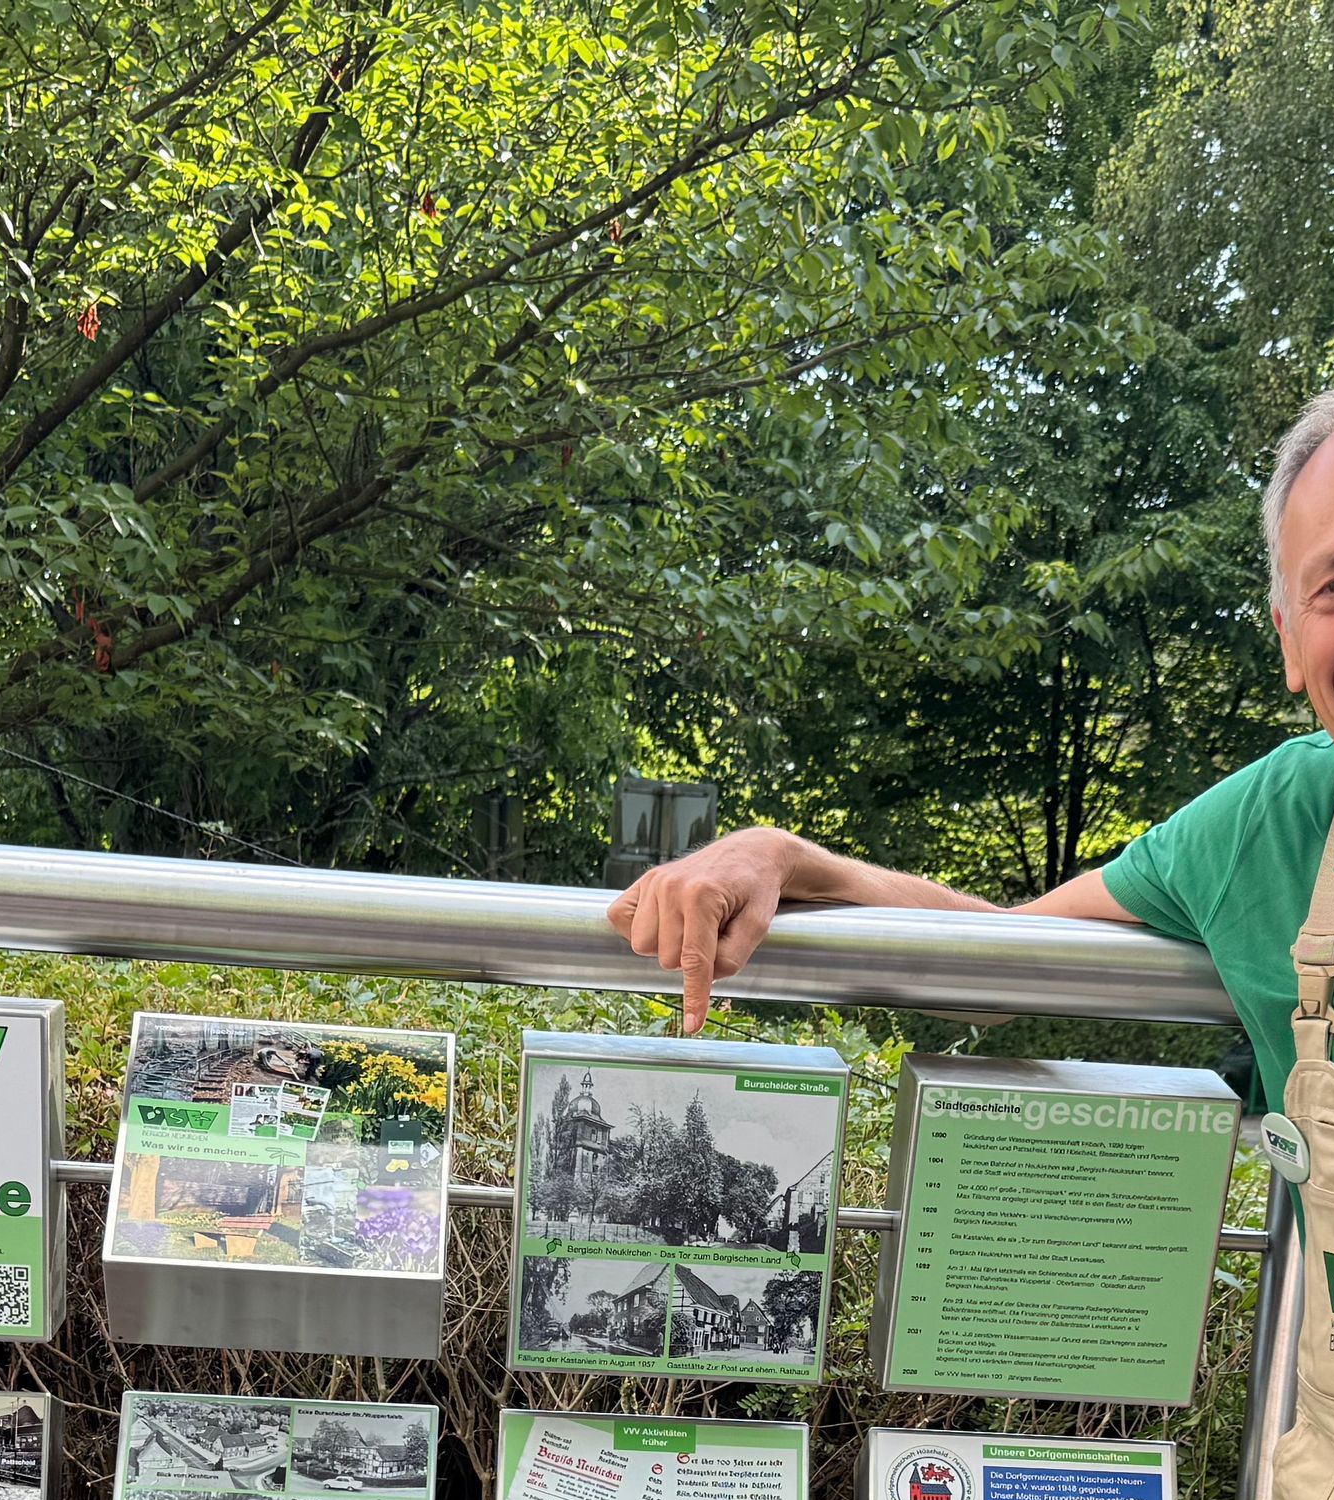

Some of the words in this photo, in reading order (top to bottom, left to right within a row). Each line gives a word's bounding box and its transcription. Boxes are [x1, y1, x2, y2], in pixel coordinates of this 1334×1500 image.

[744, 1080, 798, 1091] Burscheider
[800, 1083, 830, 1093] Straße
[922, 1086, 1234, 1134] Stadtgeschichte
[934, 1100, 1021, 1114] Stadtgeschichte
[141, 1140, 164, 1149] Was
[203, 1148, 247, 1157] machen
[567, 1245, 603, 1255] Bergisch
[605, 1247, 652, 1258] Neukirchen
[660, 1249, 676, 1258] Das
[678, 1250, 691, 1259] Tor
[713, 1252, 759, 1264] Bergischen
[761, 1255, 782, 1265] Land
[517, 1354, 545, 1364] Fällung
[561, 1357, 597, 1366] Kastanien
[610, 1360, 636, 1369] August
[667, 1362, 705, 1371] Gaststätte
[739, 1365, 754, 1373] und
[780, 1367, 810, 1376] Rathaus
[623, 1427, 641, 1435] VVV
[642, 1428, 688, 1438] Aktivitäten
[642, 1438, 668, 1447] früher
[989, 1447, 1025, 1457] Unsere
[1028, 1448, 1130, 1462] Dorfgemeinschaften
[990, 1471, 1004, 1479] Die
[1006, 1472, 1075, 1483] Dorfgemeinschaft
